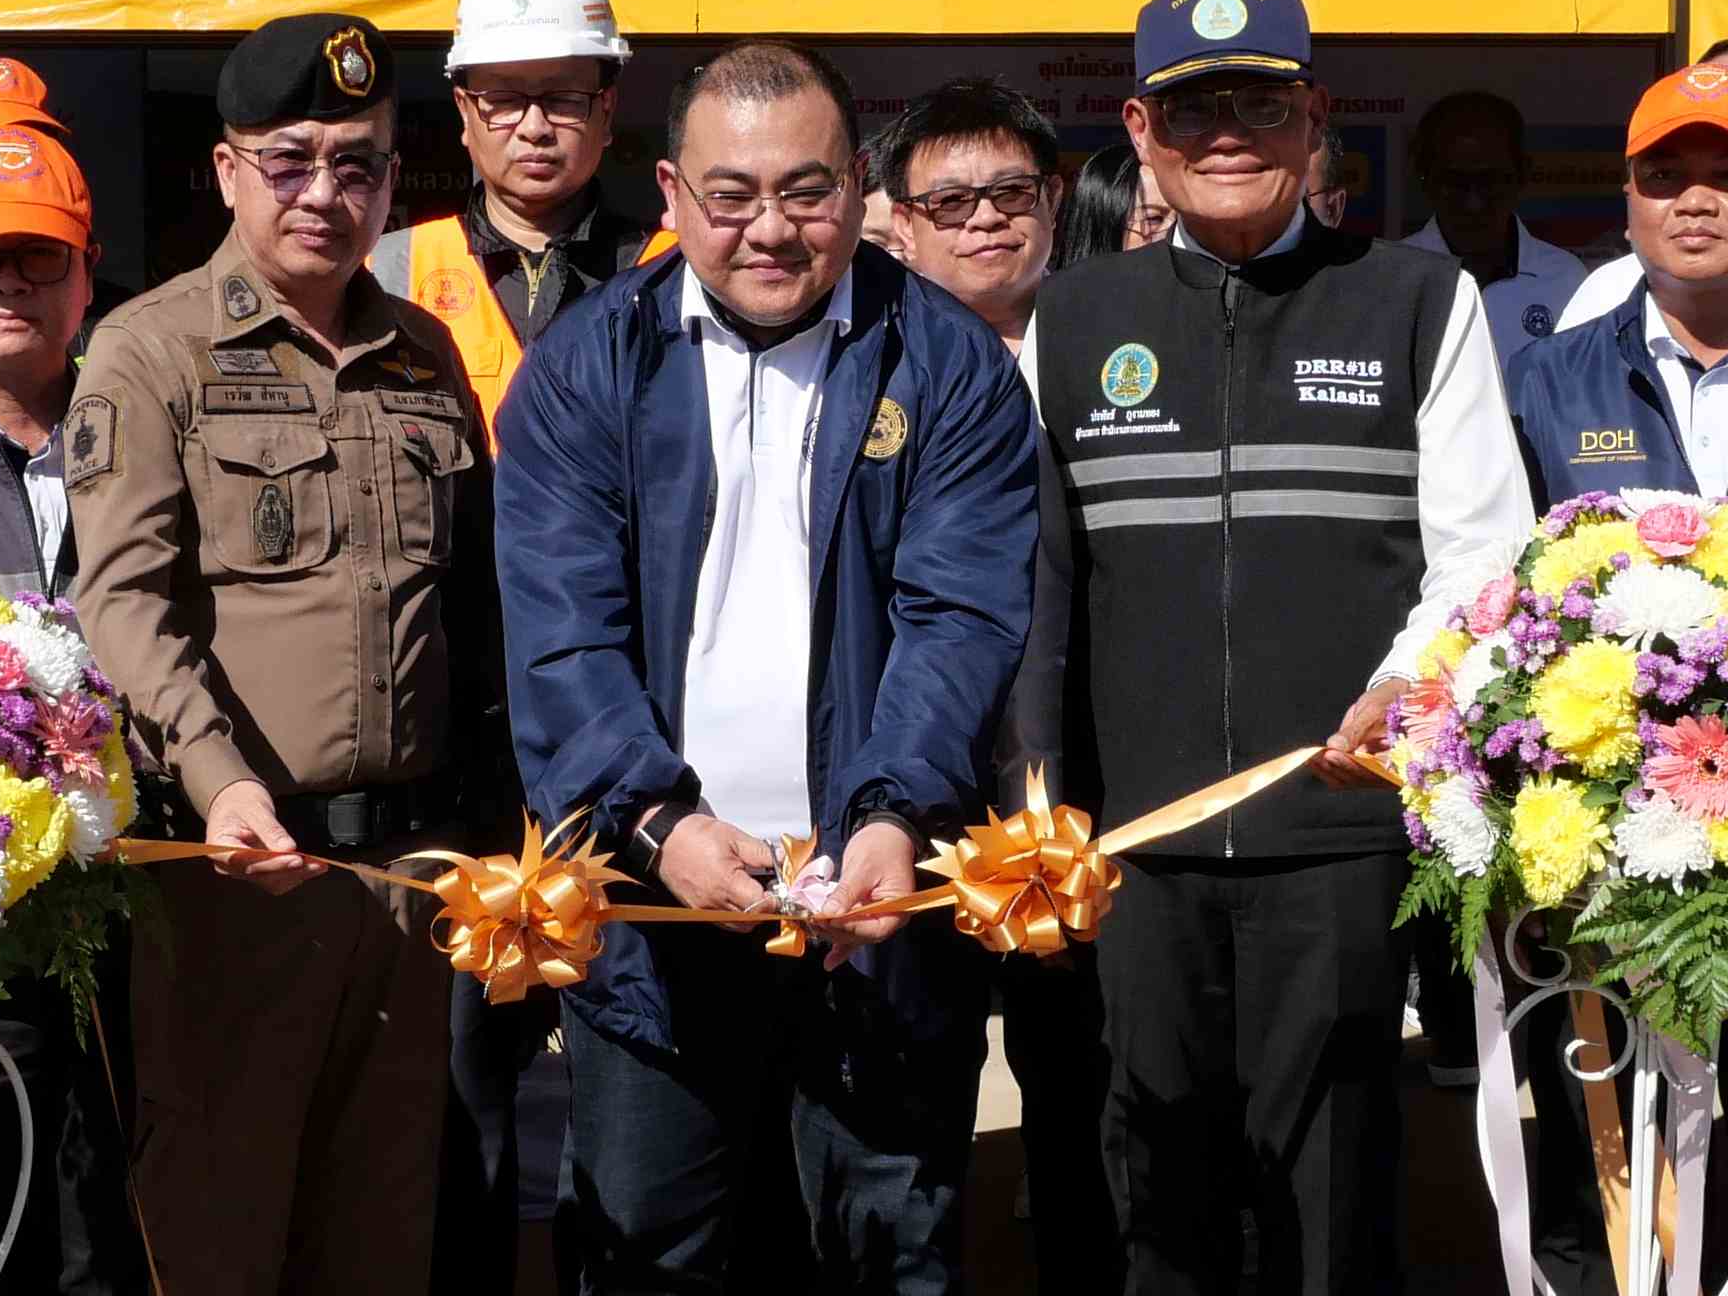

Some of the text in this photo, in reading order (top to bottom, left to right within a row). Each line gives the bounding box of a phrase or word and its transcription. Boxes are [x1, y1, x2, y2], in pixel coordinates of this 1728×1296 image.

[1293, 358, 1383, 378] DRR#16
[1298, 385, 1382, 407] Kalasin
[1580, 429, 1635, 452] DOH
